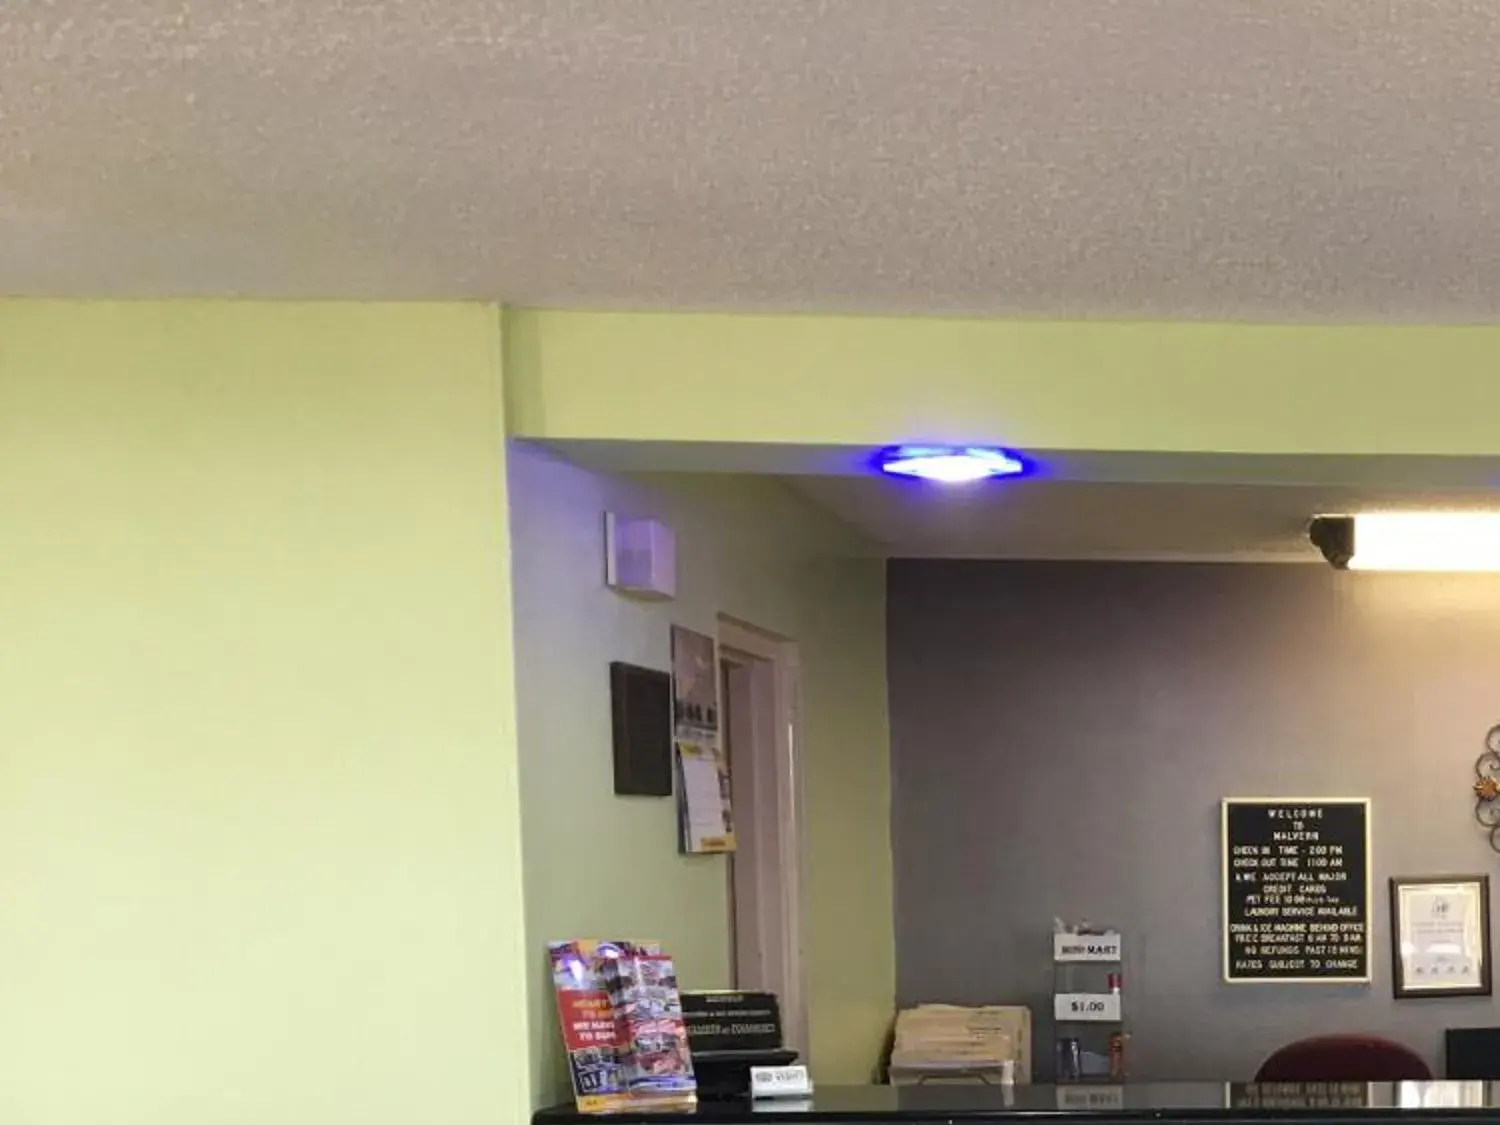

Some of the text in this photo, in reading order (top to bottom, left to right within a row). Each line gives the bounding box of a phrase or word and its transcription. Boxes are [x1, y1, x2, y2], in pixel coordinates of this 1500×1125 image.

[1268, 808, 1323, 818] WELCOME
[1293, 820, 1304, 830] TO
[1273, 831, 1319, 840] MALVERN
[1233, 845, 1258, 855] CHECK
[1278, 845, 1298, 855] TIME
[1330, 845, 1343, 855] PM
[1233, 857, 1258, 867] CHECK
[1280, 857, 1299, 867] TIME
[1330, 857, 1343, 867] AM
[1263, 872, 1296, 881] ACCEPT
[1297, 872, 1314, 881] ALL
[1318, 872, 1347, 881] MAJOR
[1263, 884, 1327, 893] CREDIT CARDS
[1244, 907, 1358, 916] LAUNDRY SERVICE AVAILABLE
[1260, 933, 1305, 943] BREAKFAST
[1260, 945, 1300, 955] REFUNDS
[1325, 960, 1358, 969] CHANGE
[1071, 1002, 1105, 1012] $1.00
